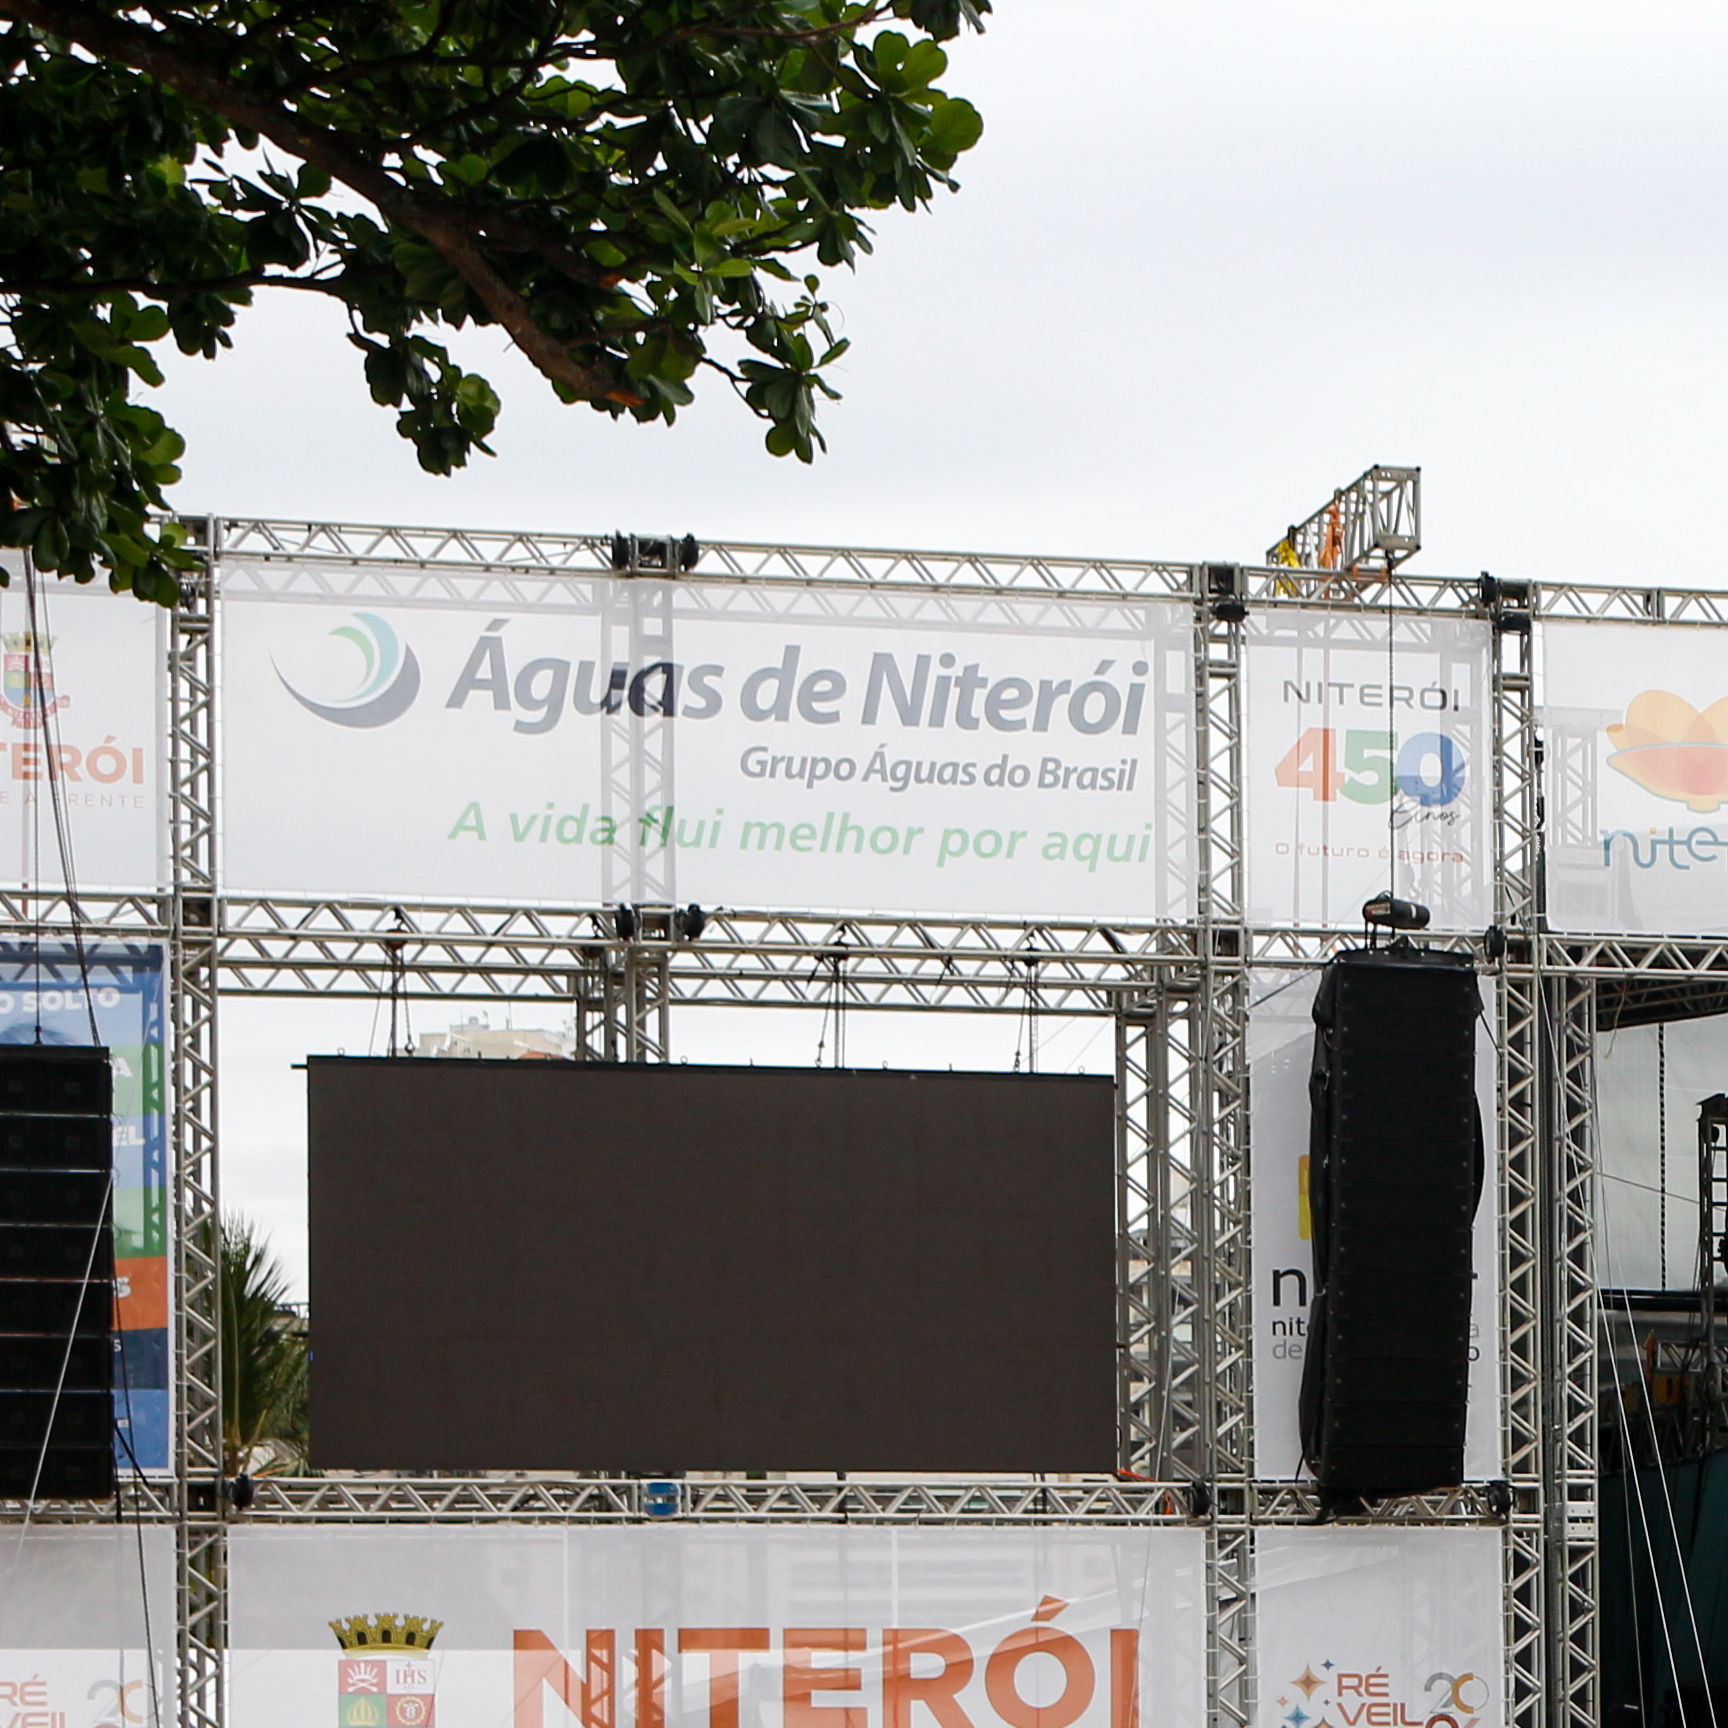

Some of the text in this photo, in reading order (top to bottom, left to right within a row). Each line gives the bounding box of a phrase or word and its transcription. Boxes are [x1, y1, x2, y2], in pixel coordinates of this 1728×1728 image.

[445, 618, 1150, 736] Águas de Niterói
[1283, 680, 1459, 712] NITERÓI
[740, 742, 1138, 792] Grupo Águas do Brasil
[1275, 727, 1467, 807] 450
[449, 802, 1152, 871] A vida flui melhor por aqui
[1275, 843, 1289, 854] O
[1299, 843, 1369, 858] futuro
[1399, 850, 1464, 863] agora
[1336, 1665, 1389, 1697] RÉ
[1336, 1701, 1424, 1726] VEIL
